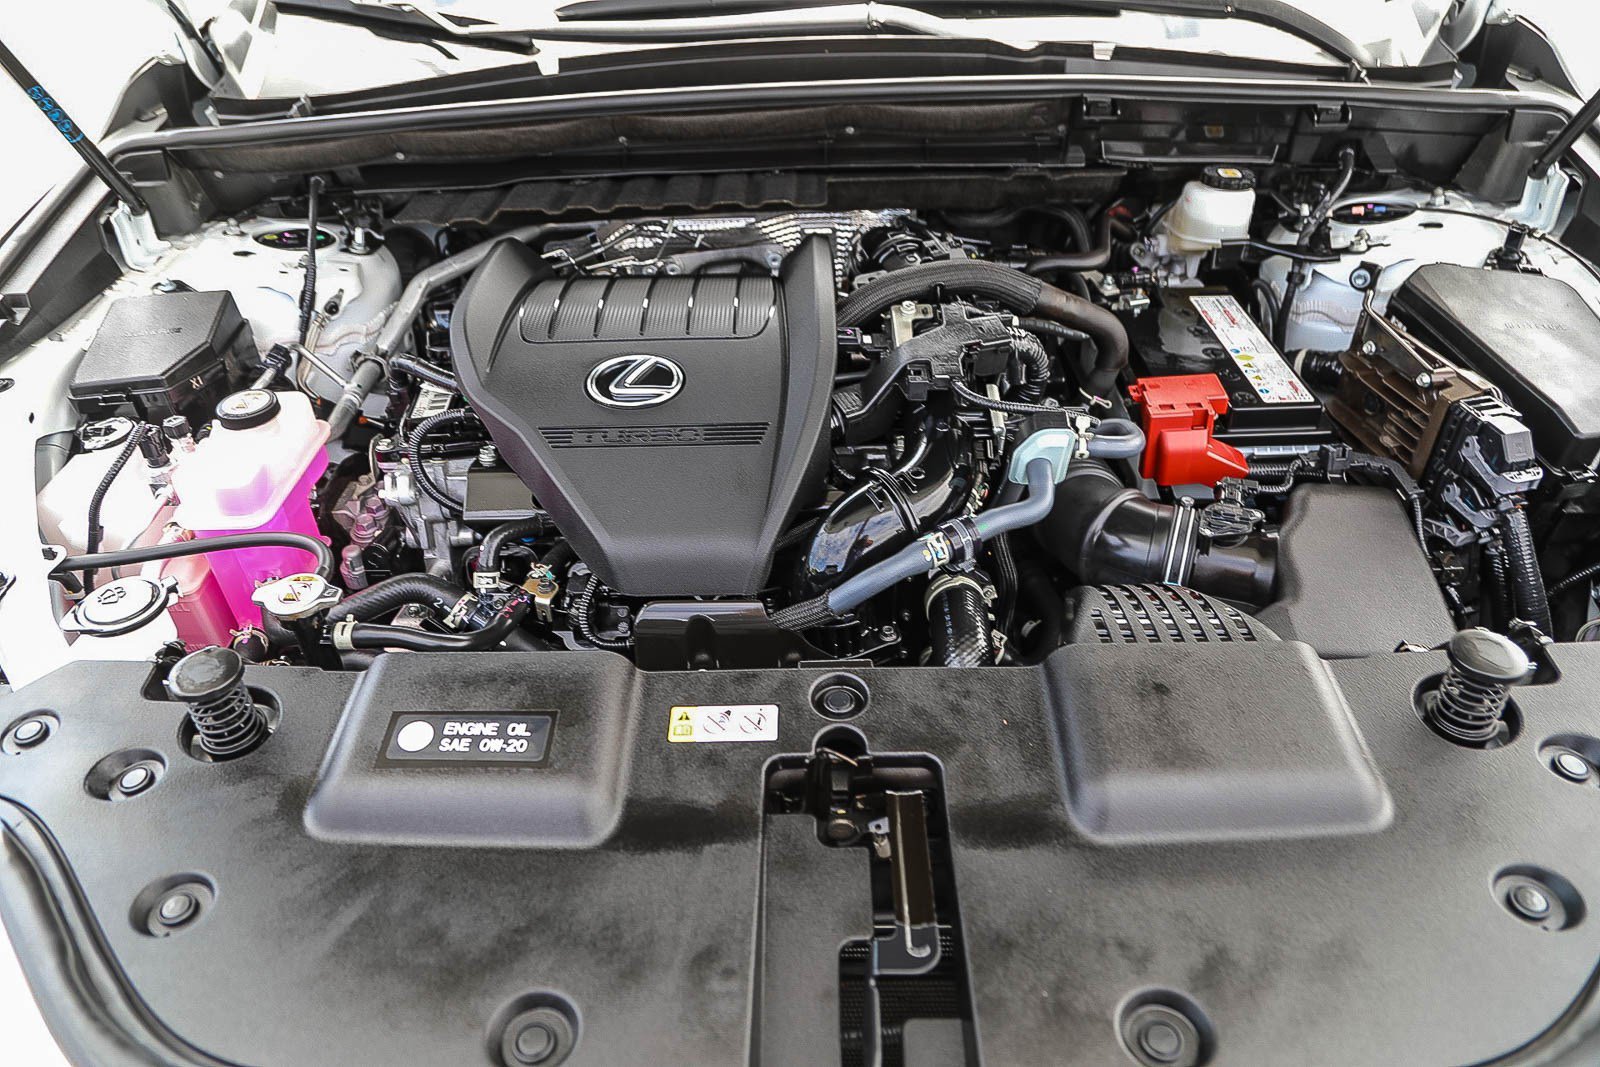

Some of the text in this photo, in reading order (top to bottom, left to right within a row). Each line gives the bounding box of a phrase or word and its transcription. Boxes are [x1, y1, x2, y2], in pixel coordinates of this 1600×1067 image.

[574, 427, 702, 444] TURBO
[443, 721, 532, 737] ENGINE OIL
[438, 737, 528, 753] SAE 0W-20
